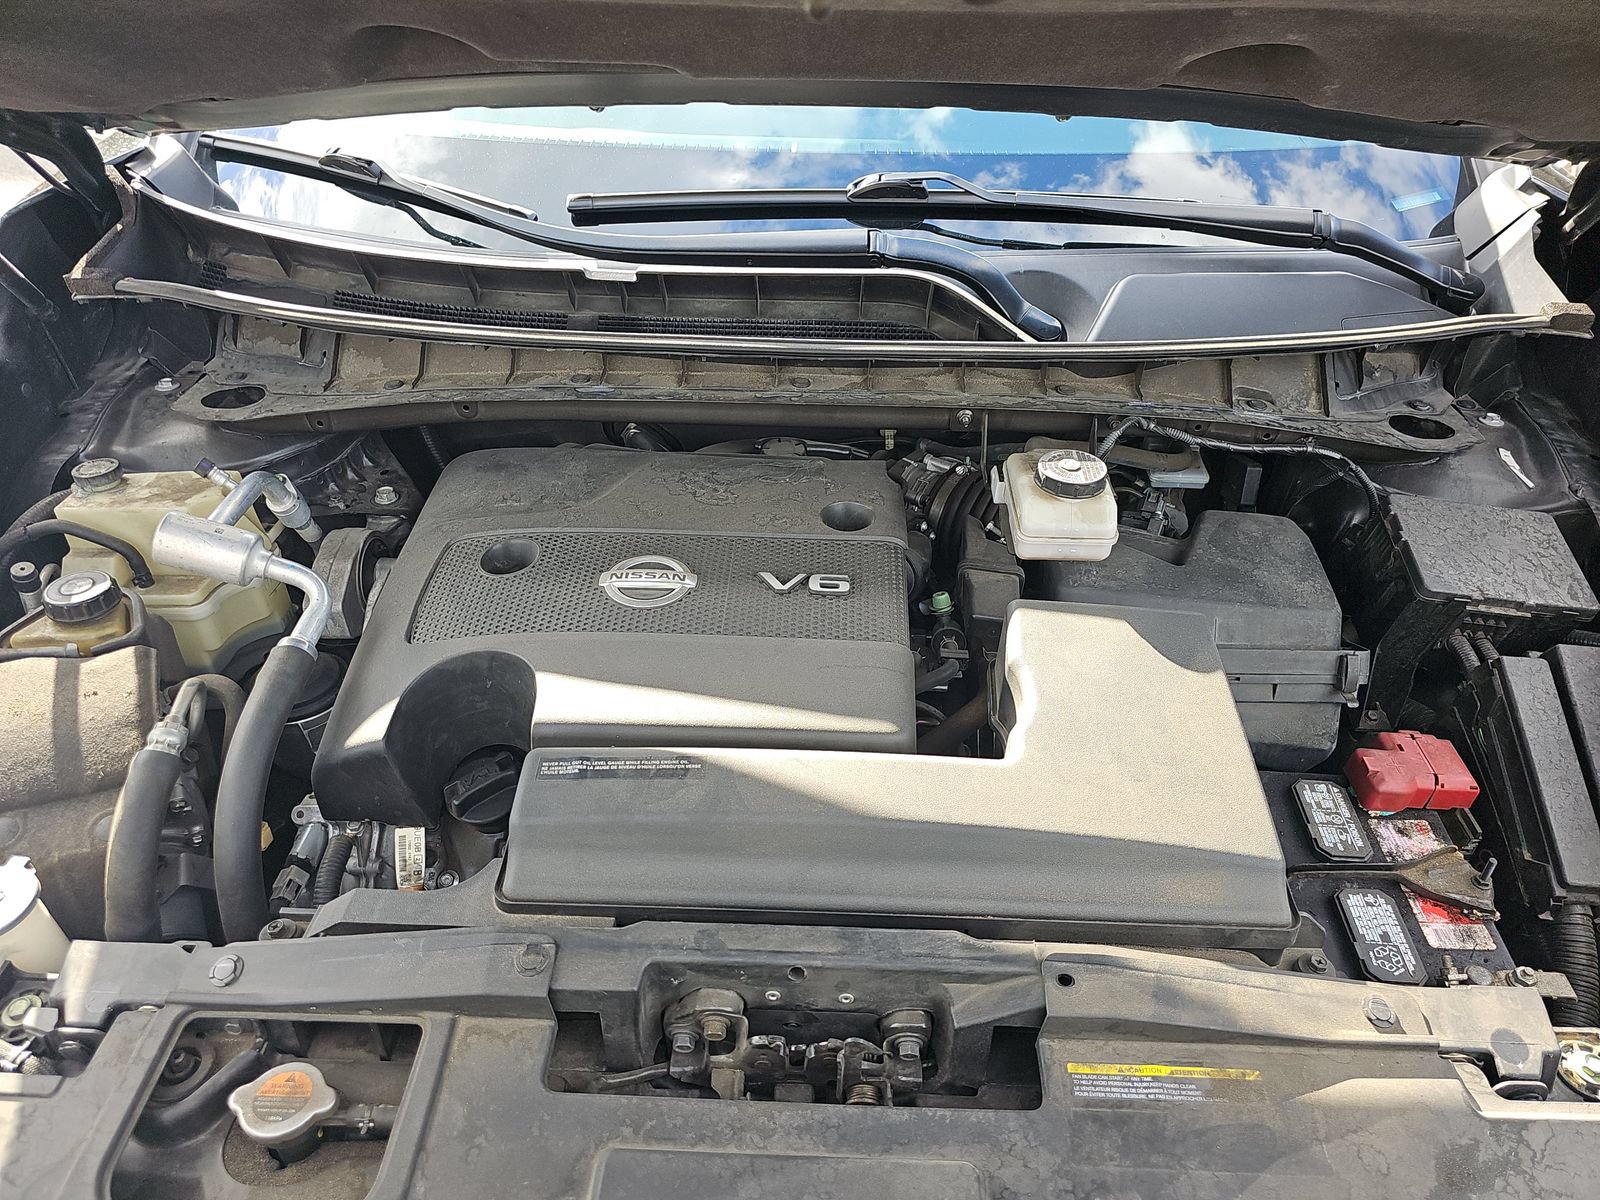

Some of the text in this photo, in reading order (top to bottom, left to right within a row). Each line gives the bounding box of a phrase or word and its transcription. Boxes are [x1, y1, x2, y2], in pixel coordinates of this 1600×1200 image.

[609, 572, 687, 581] NISSAN
[757, 571, 851, 595] V6
[1335, 793, 1351, 818] DANGER
[1348, 824, 1364, 847] POISON
[1130, 1066, 1162, 1074] CAUTION
